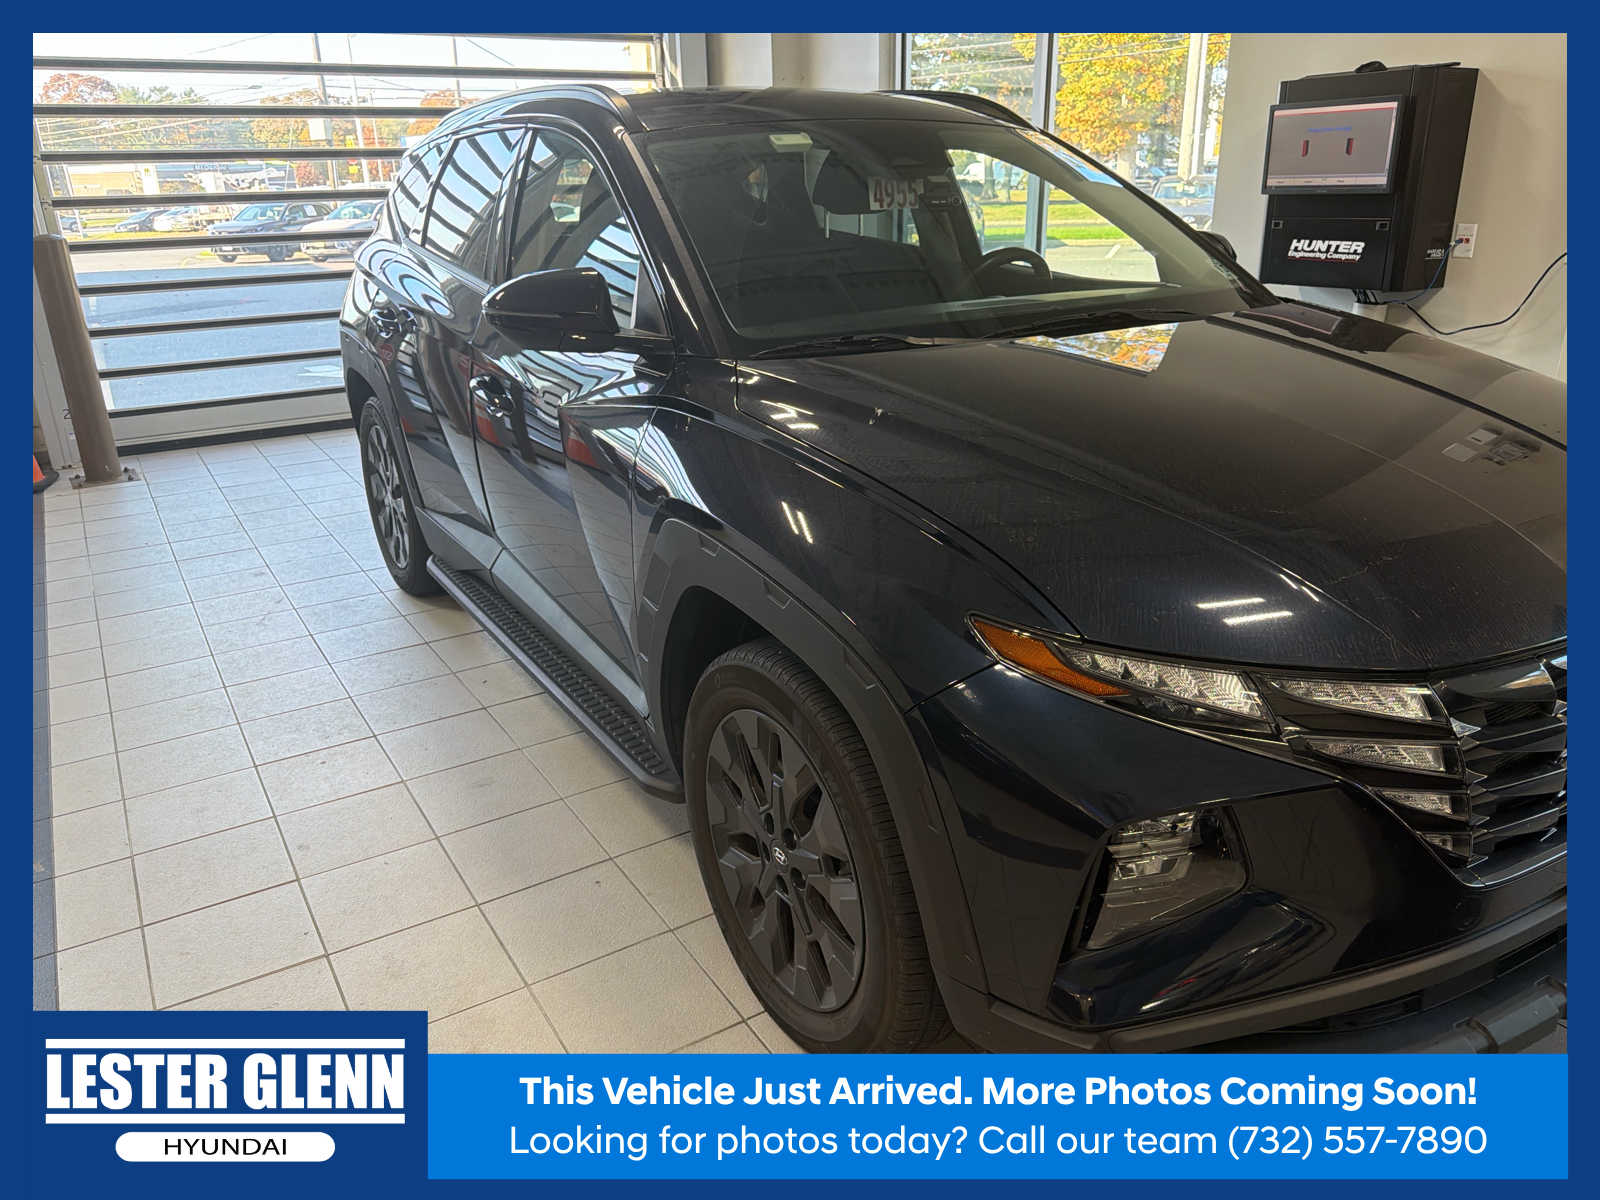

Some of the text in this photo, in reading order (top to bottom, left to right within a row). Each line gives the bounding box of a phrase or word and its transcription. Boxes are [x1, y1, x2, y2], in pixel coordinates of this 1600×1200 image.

[1290, 239, 1365, 253] HUNTER
[1288, 250, 1361, 262] Engineering Company
